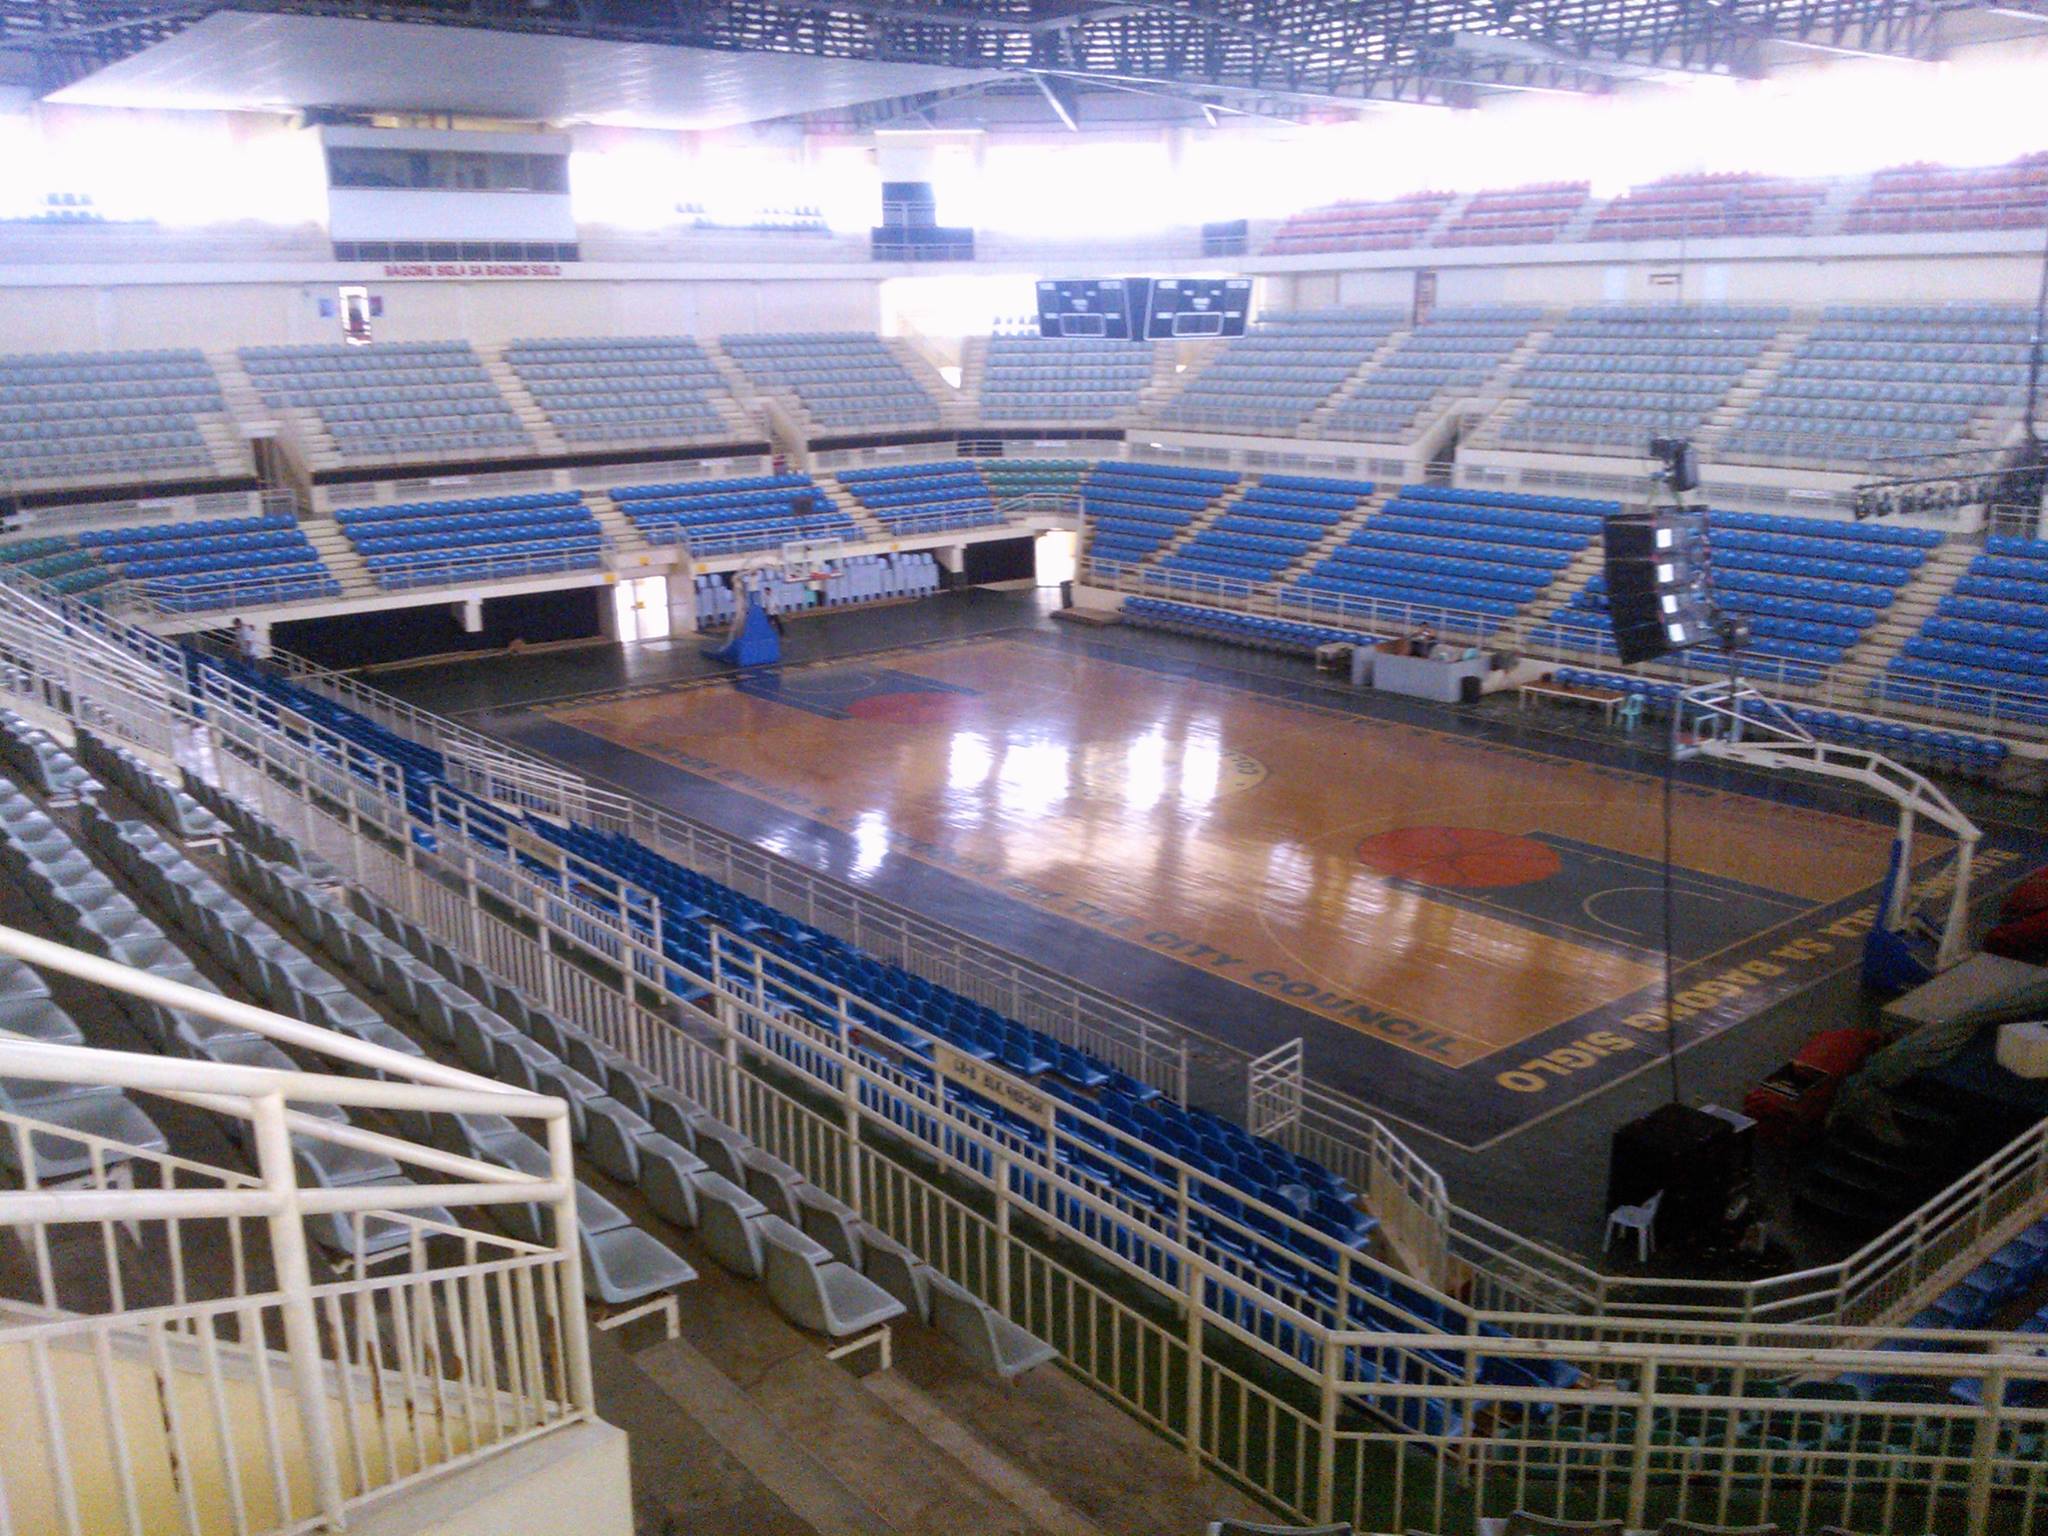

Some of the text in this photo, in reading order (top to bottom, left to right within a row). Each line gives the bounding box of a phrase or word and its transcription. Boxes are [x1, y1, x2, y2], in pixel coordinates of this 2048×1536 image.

[1144, 931, 1244, 966] CITY
[1252, 970, 1457, 1055] COUNCIL
[1620, 959, 1785, 1033] BAGONG
[1495, 1031, 1637, 1093] SIGLO
